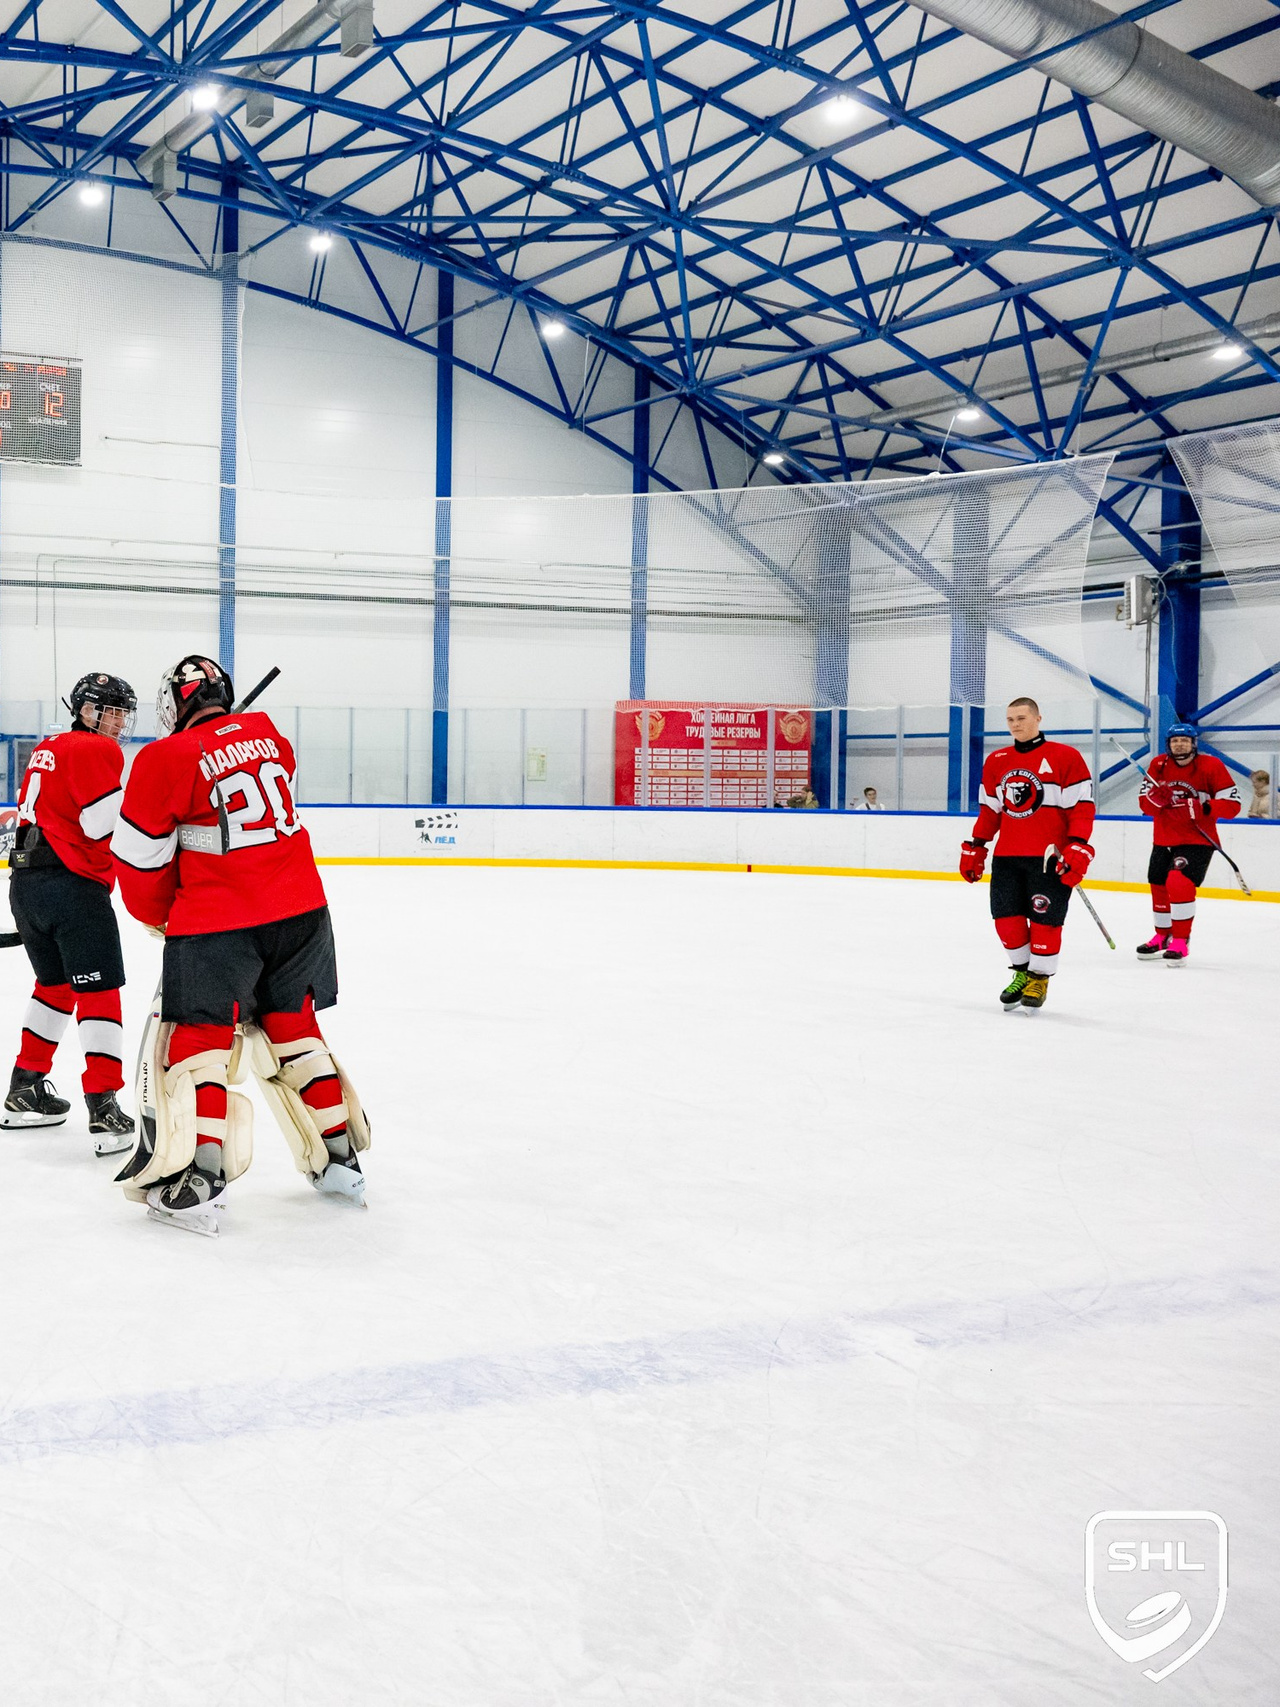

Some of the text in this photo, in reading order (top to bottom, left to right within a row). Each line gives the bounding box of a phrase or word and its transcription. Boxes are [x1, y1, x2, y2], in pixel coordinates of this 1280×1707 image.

[44, 392, 63, 417] 12
[736, 713, 756, 724] ЛИГА
[685, 726, 761, 738] ТРУДВЫЕ РЕЗЕРВЫ
[1019, 770, 1043, 790] EDITION
[209, 761, 301, 850] 20
[1006, 808, 1034, 818] MOSCOW
[181, 830, 214, 849] BAUER
